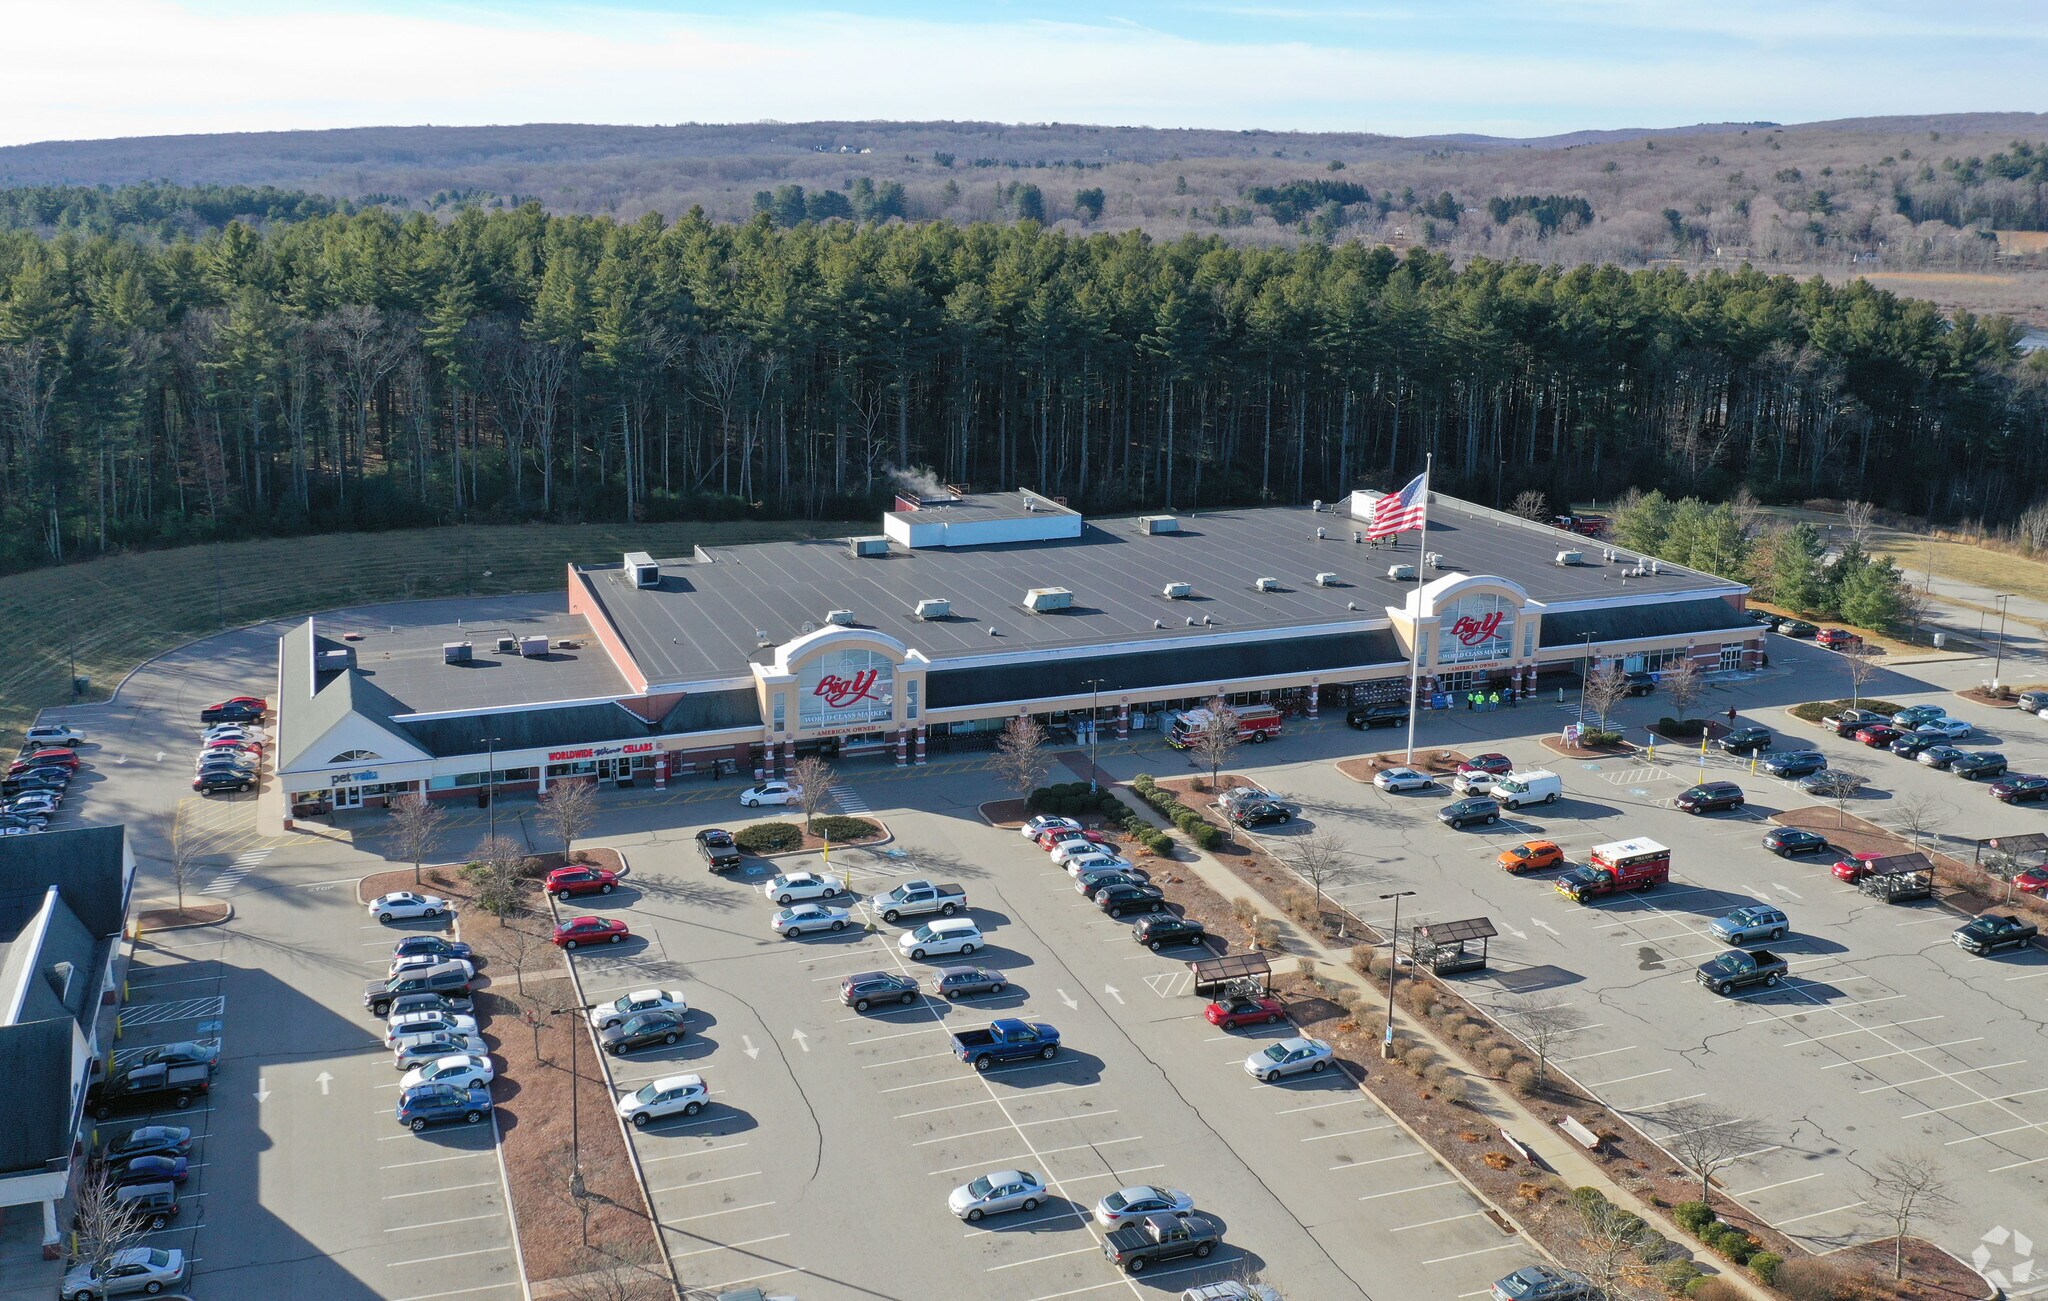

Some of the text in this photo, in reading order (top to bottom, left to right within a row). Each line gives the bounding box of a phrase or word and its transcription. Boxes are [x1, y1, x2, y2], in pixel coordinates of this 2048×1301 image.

[1451, 617, 1482, 641] Big
[813, 675, 852, 702] Big
[833, 713, 856, 721] CLASS
[858, 710, 887, 718] MARKET
[817, 728, 851, 736] AMERICAN
[548, 743, 653, 761] WORLDWIDE Wine CELLARS
[331, 772, 351, 786] pet
